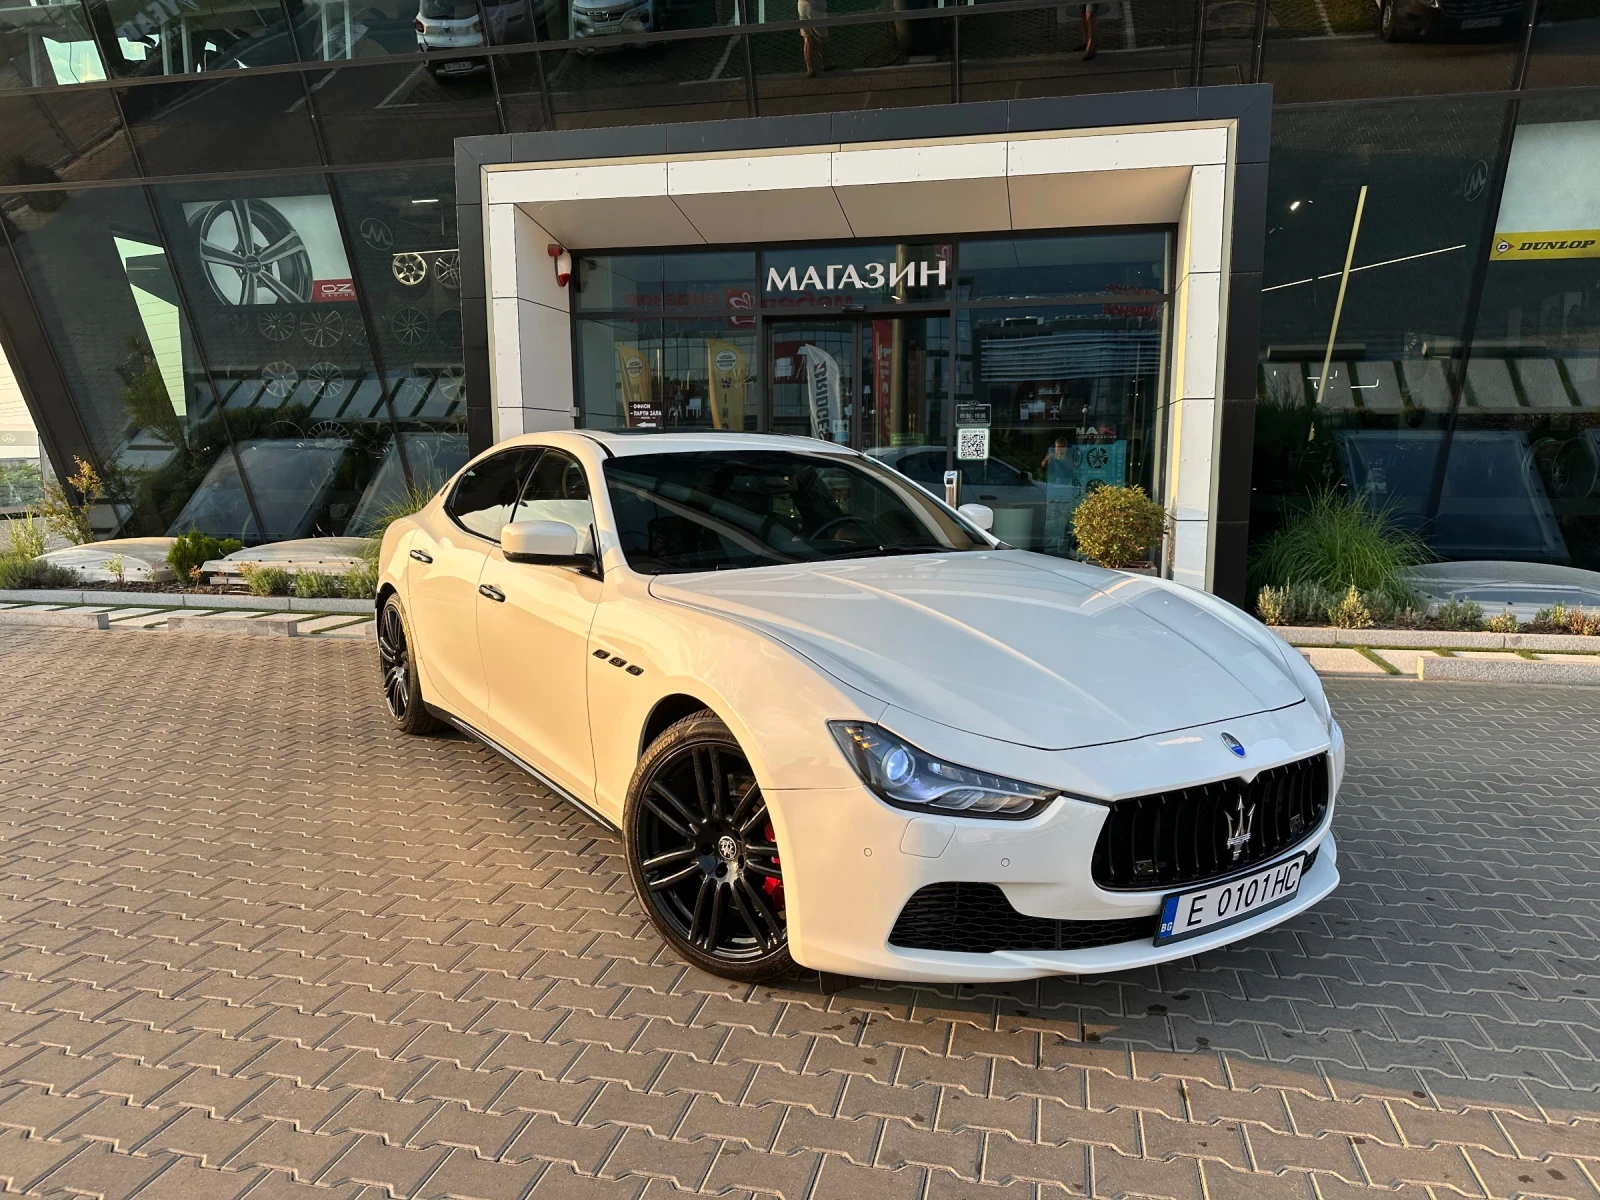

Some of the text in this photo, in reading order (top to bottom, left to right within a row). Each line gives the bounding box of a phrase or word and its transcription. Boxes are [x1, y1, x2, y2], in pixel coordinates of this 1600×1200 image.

[1518, 240, 1596, 251] DUNLOP
[766, 260, 947, 292] МАГАЗИН
[321, 283, 353, 293] OZ
[1076, 425, 1116, 435] MAK
[1161, 921, 1173, 933] BG
[1187, 893, 1208, 927] E
